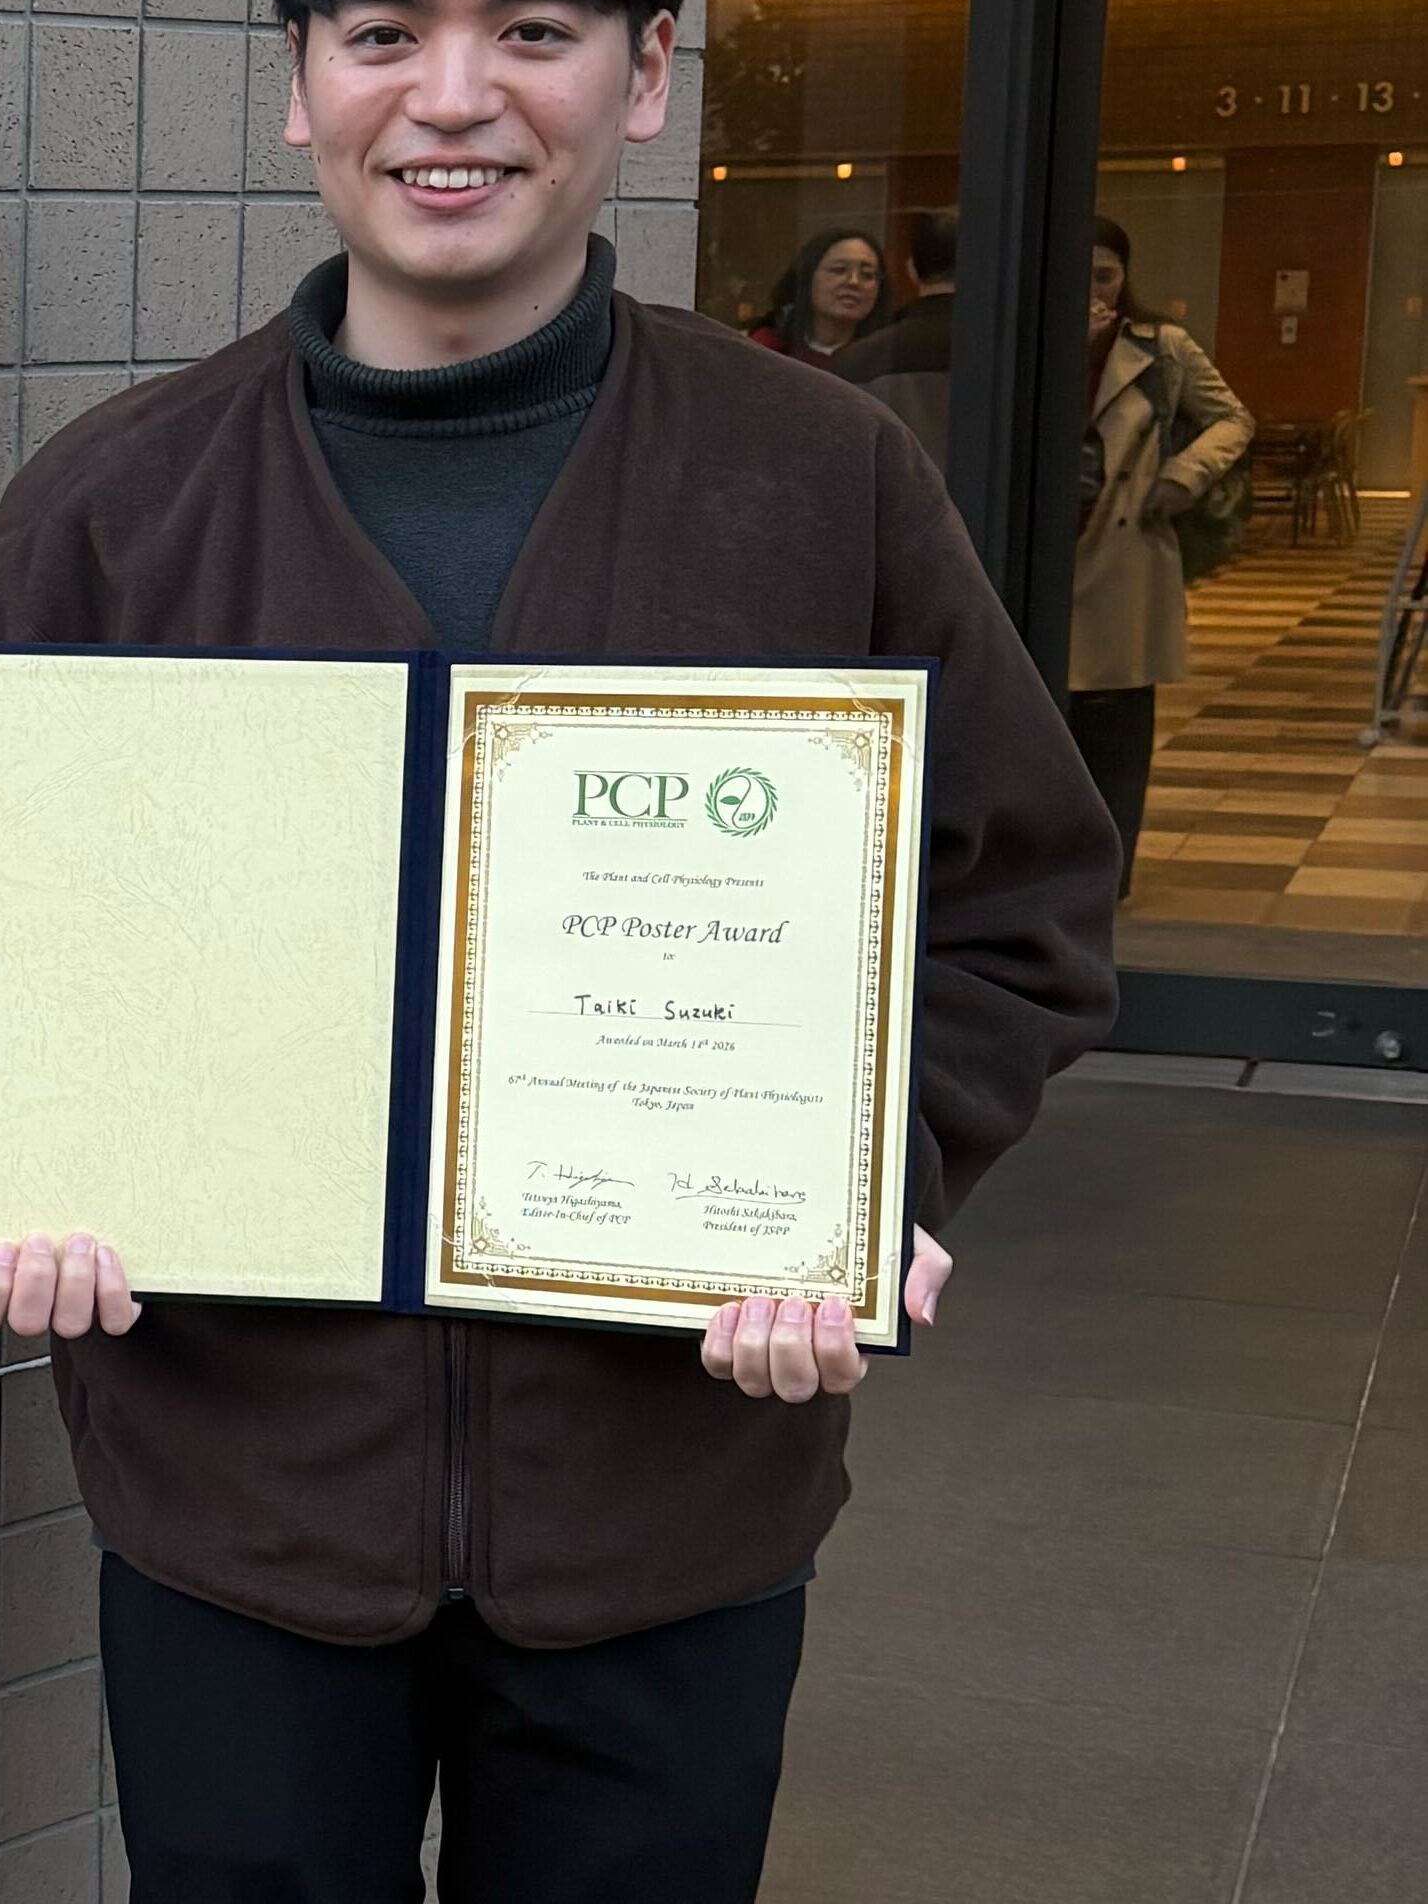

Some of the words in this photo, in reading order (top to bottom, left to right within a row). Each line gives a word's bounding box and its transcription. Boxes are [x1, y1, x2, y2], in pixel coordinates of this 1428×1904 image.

[1216, 86, 1237, 117] 3
[1279, 84, 1310, 114] 11
[1357, 81, 1394, 113] 13
[573, 773, 689, 818] PCP
[631, 872, 652, 883] and
[651, 874, 671, 884] Cell
[562, 915, 617, 938] PCP
[621, 916, 697, 940] Poster
[697, 920, 790, 944] Award
[574, 994, 637, 1015] Taiki
[664, 1000, 735, 1020] Suzuki
